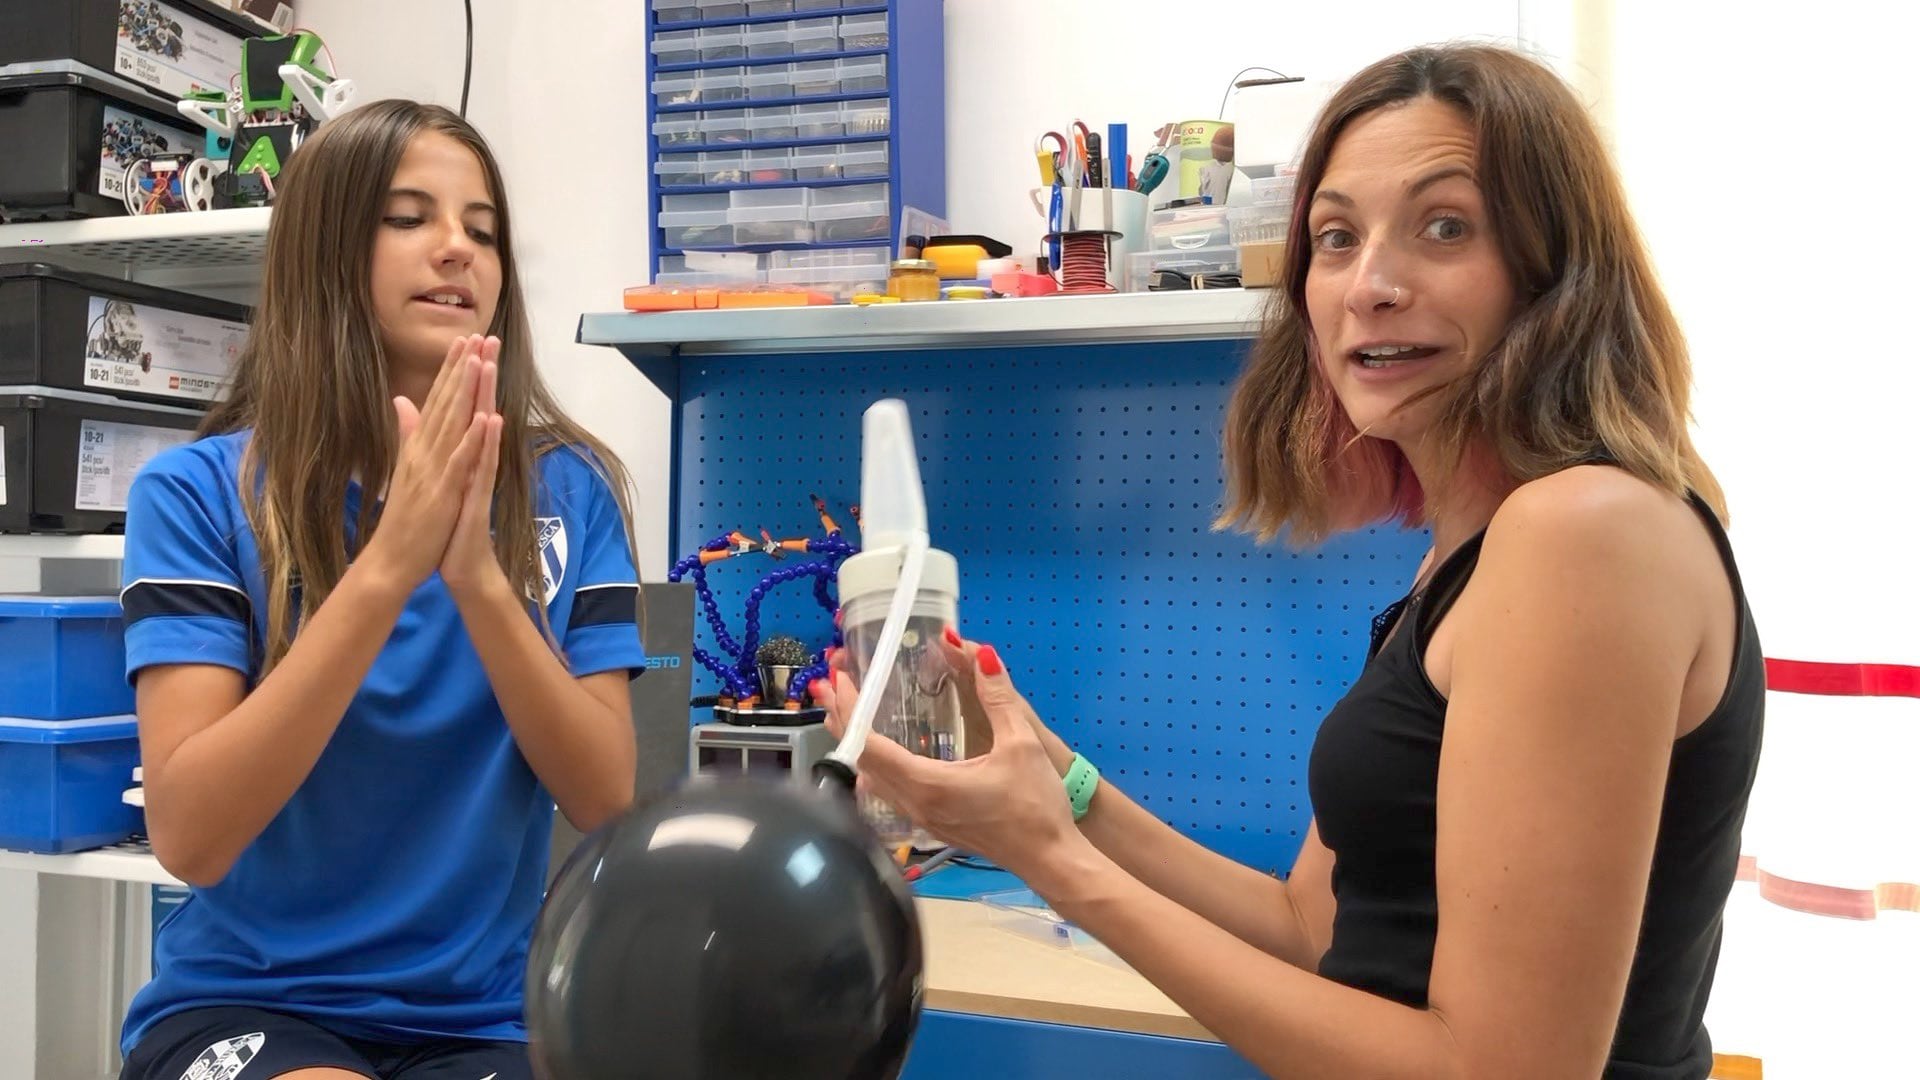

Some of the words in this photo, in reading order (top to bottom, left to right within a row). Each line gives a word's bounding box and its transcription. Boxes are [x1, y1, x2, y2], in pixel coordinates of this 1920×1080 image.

[120, 56, 132, 70] 10+
[104, 178, 123, 193] 10-21
[90, 368, 109, 381] 10-21
[84, 431, 104, 443] 10-21
[82, 453, 93, 463] 541
[645, 656, 680, 669] ESTO
